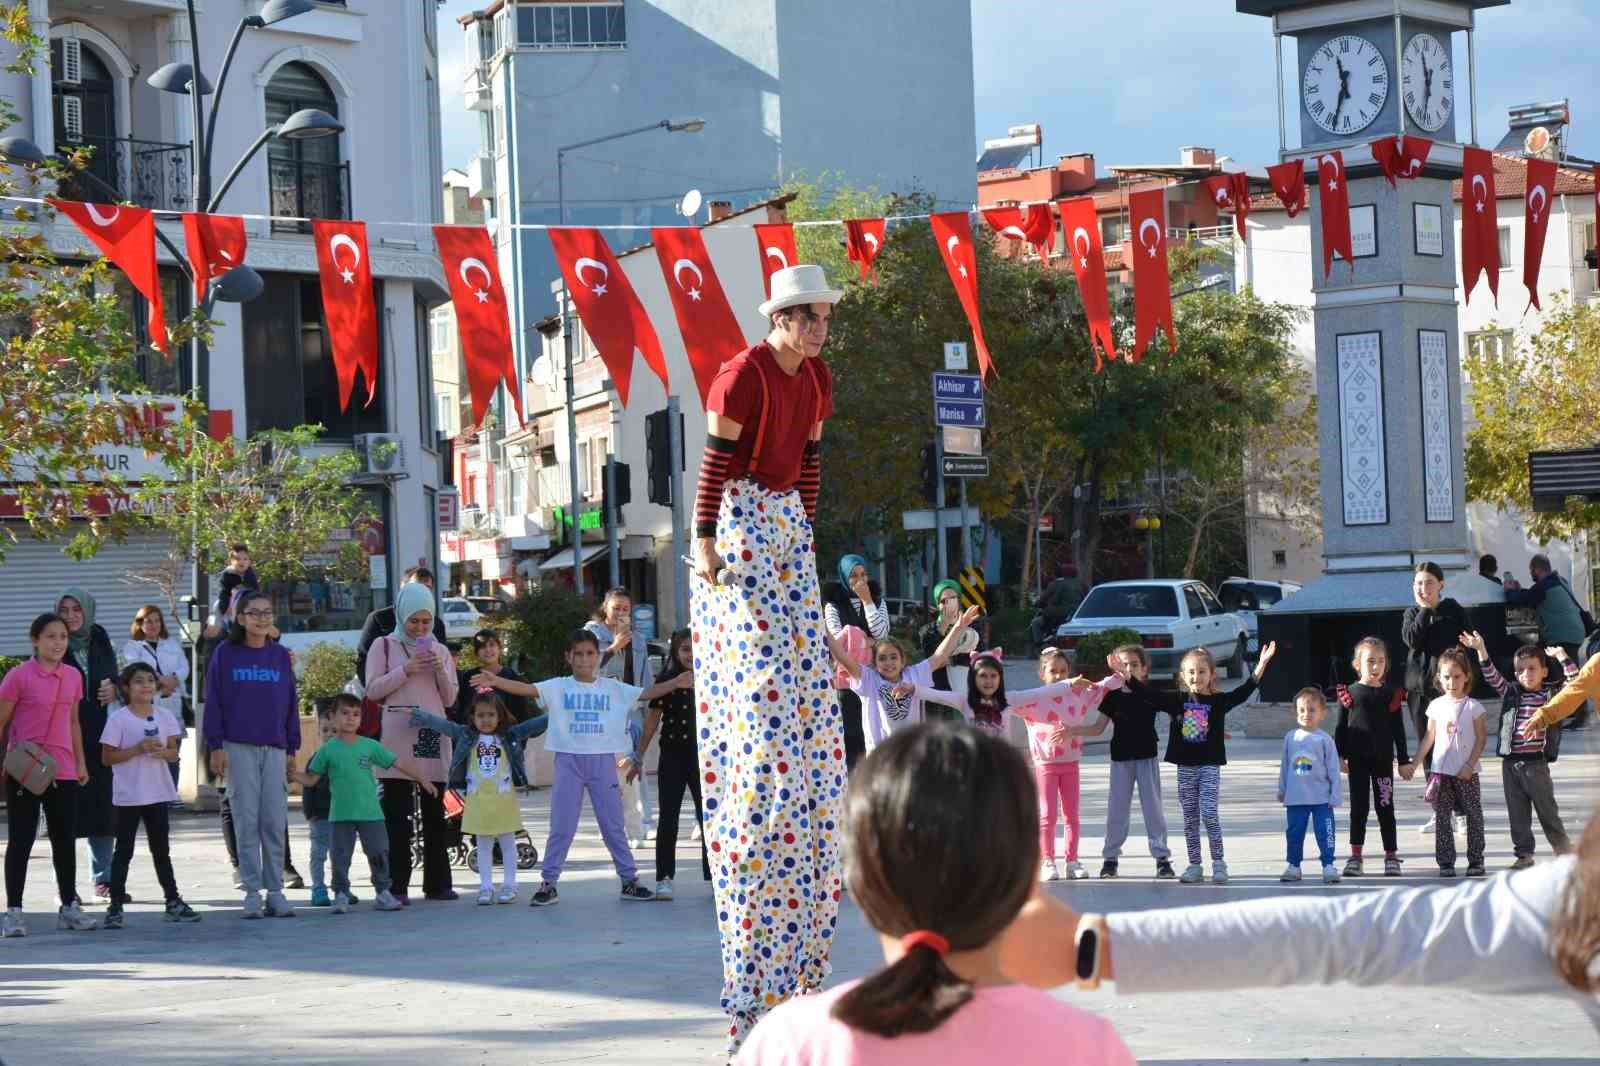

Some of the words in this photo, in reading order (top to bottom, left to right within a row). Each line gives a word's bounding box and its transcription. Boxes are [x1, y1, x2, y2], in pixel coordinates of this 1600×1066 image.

[938, 379, 966, 393] Akhisar
[939, 407, 965, 420] Manisa
[233, 664, 280, 682] miav
[564, 693, 610, 711] MIAMI
[569, 723, 604, 734] FLORIDA
